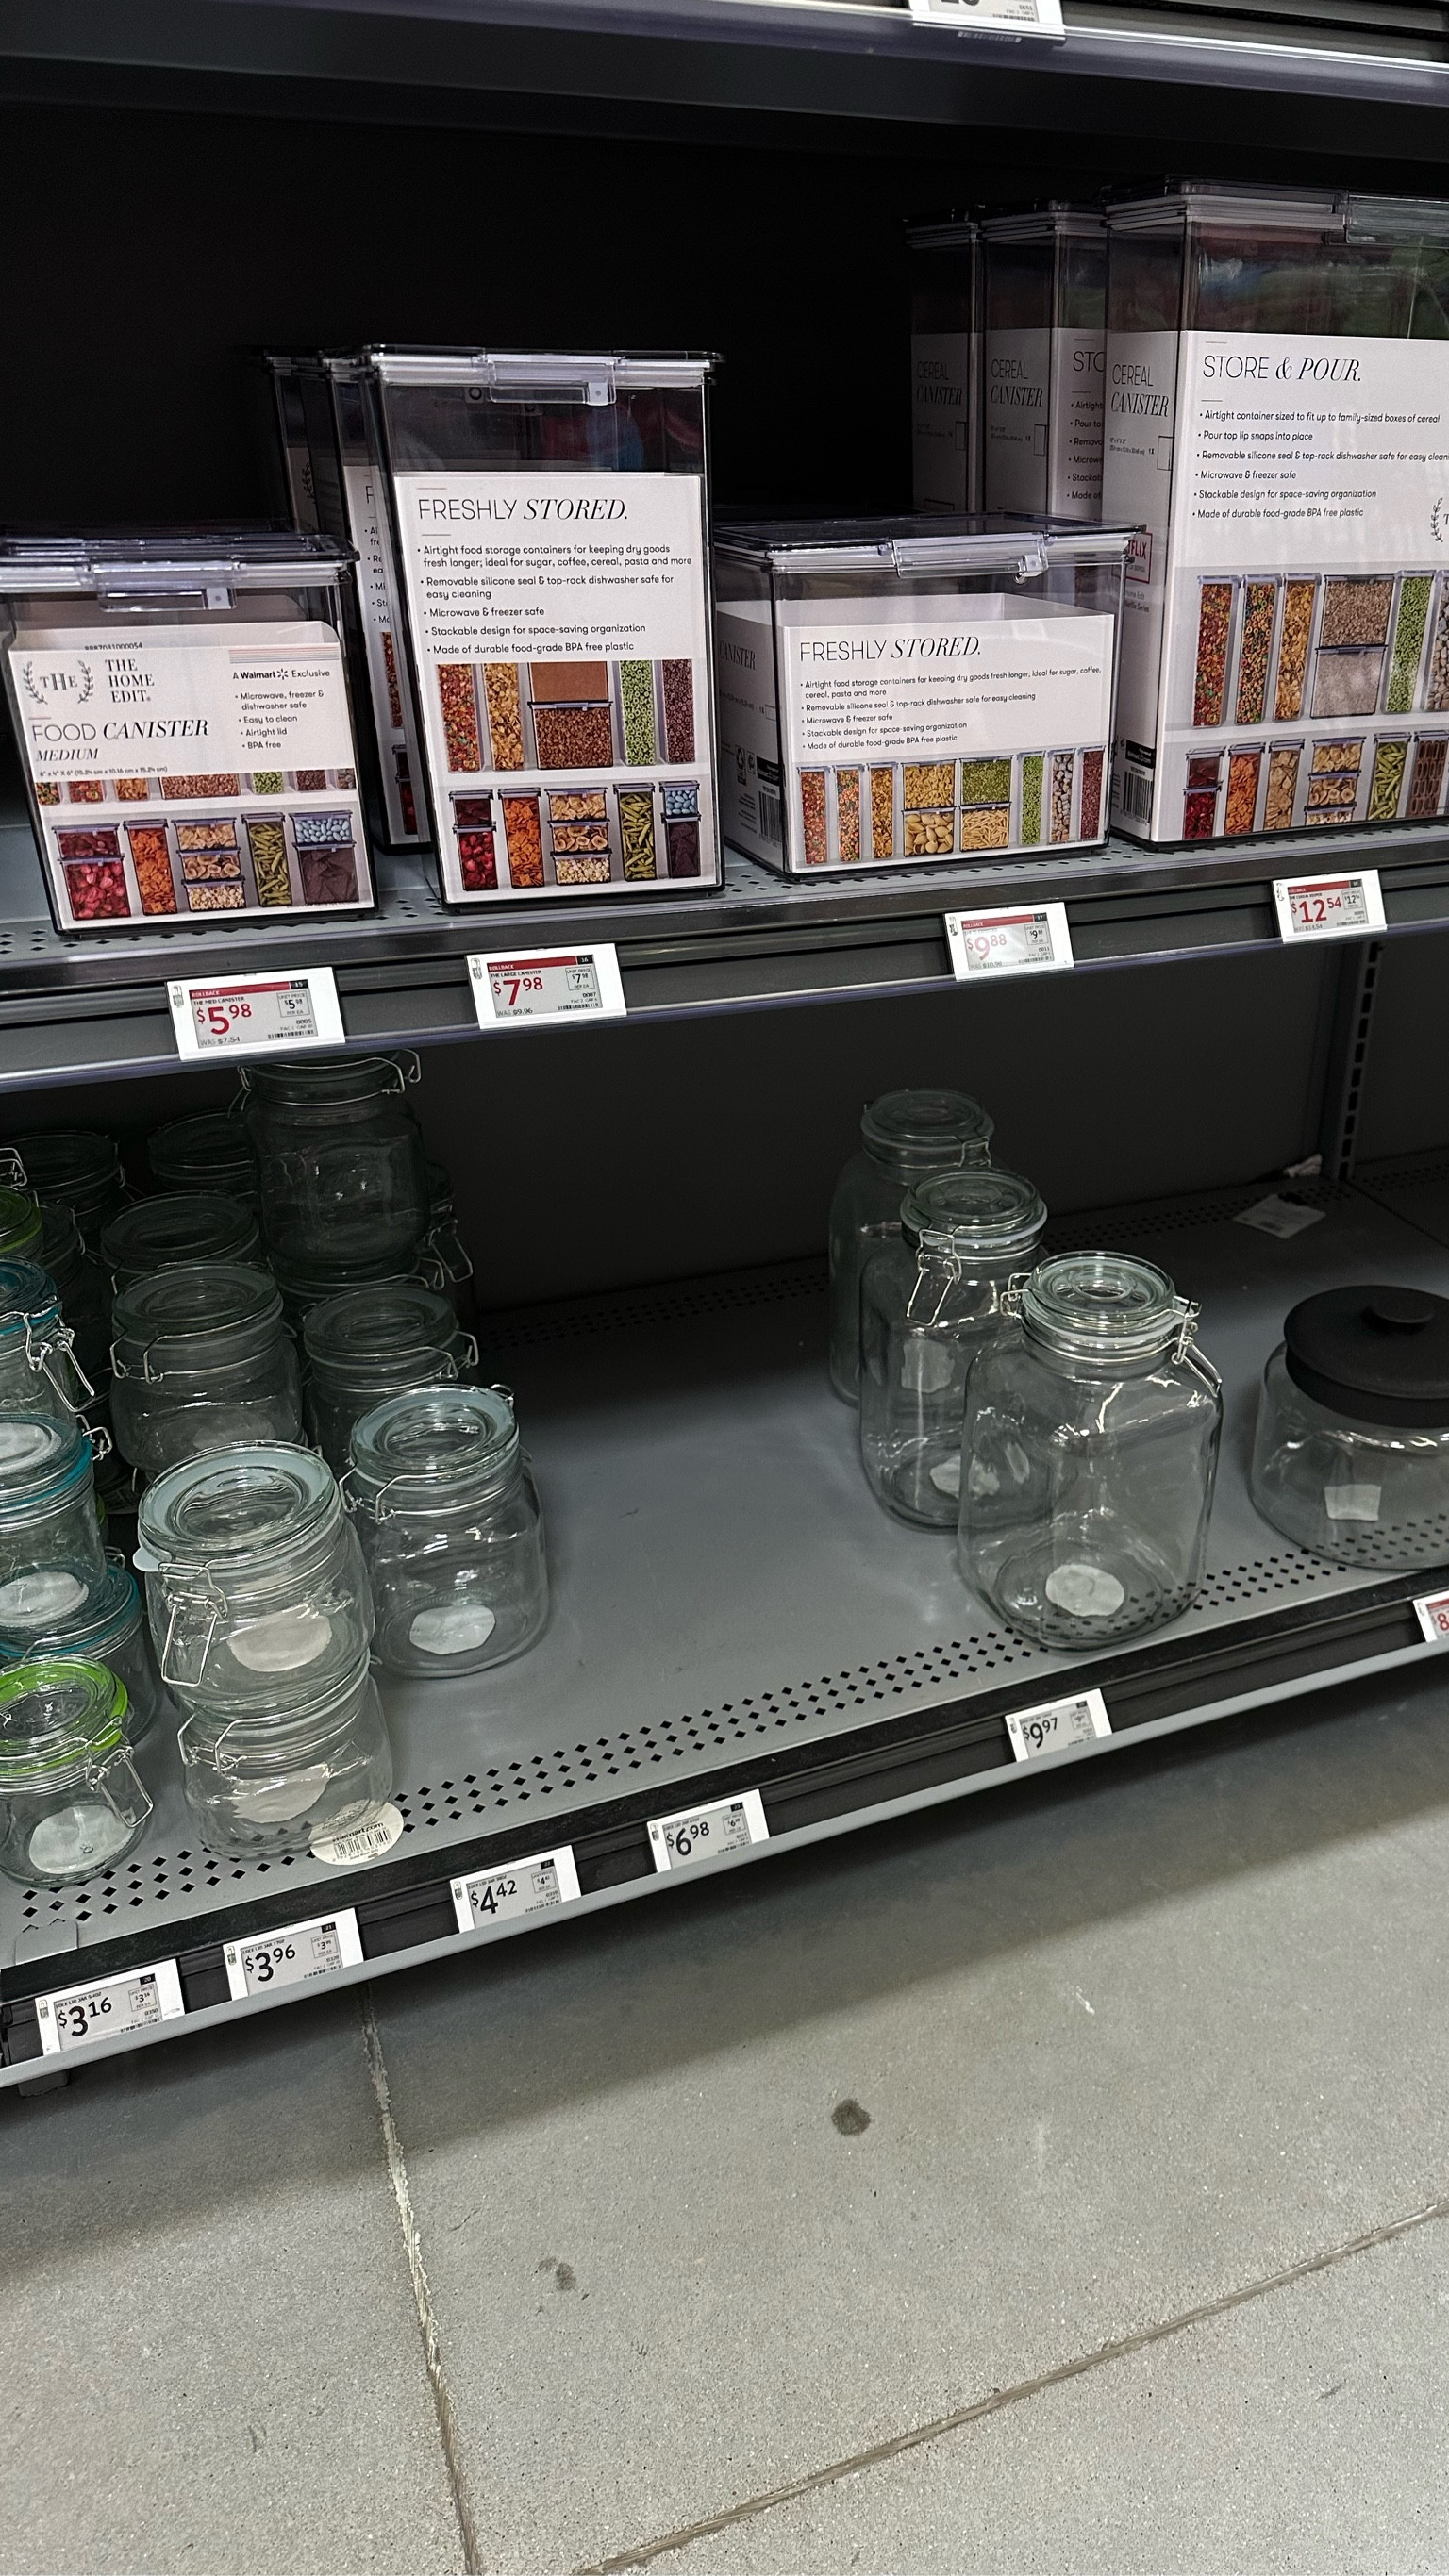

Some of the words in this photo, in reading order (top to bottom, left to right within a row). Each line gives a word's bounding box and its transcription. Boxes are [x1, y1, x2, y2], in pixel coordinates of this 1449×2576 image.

[991, 358, 1028, 380] CEREAL
[1112, 364, 1154, 387] CEREAL
[1203, 355, 1270, 379] STORE
[1275, 357, 1293, 380] &
[1296, 357, 1361, 382] POUR.
[991, 384, 1043, 407] CANISTER
[1110, 391, 1169, 417] CANISTER
[1204, 409, 1235, 423] Airtight
[1236, 410, 1274, 421] container
[1274, 410, 1296, 421] sized
[1296, 412, 1306, 422] to
[1306, 411, 1315, 422] fit
[1316, 414, 1327, 424] up
[1327, 412, 1337, 422] to
[1338, 411, 1384, 424] family-sized
[1384, 412, 1407, 423] boxes
[1407, 413, 1417, 424] of
[1416, 414, 1441, 424] cereal
[1203, 429, 1223, 440] Pour
[1224, 431, 1239, 442] top
[1239, 430, 1250, 442] lip
[1250, 432, 1274, 442] snaps
[1274, 430, 1291, 440] into
[1291, 431, 1314, 442] place
[1202, 450, 1246, 460] Removable
[1246, 450, 1276, 460] silicone
[1277, 450, 1294, 460] seal
[1294, 450, 1301, 460] &
[1302, 451, 1335, 462] top-rack
[1335, 450, 1378, 460] dishwasher
[1378, 451, 1396, 461] safe
[1396, 451, 1408, 461] for
[1408, 454, 1427, 463] easy
[1200, 470, 1243, 480] Microwave
[1244, 469, 1251, 480] &
[1252, 470, 1279, 479] freezer
[1279, 470, 1297, 479] safe
[418, 498, 518, 521] FRESHLY
[523, 498, 628, 520] STORED.
[423, 545, 459, 557] Airtight
[460, 544, 483, 555] food
[485, 546, 521, 557] storage
[523, 544, 572, 555] containers
[573, 544, 587, 554] for
[588, 544, 625, 557] keeping
[625, 543, 641, 556] dry
[642, 543, 671, 556] goods
[423, 557, 448, 568] fresh
[449, 557, 483, 570] longer;
[484, 557, 508, 567] ideal
[509, 557, 524, 567] for
[525, 559, 556, 569] sugar,
[557, 557, 590, 568] coffee,
[591, 557, 623, 567] cereal,
[624, 557, 650, 568] pasta
[651, 556, 669, 566] and
[425, 576, 479, 587] Removable
[480, 576, 516, 586] silicone
[517, 575, 537, 586] seal
[538, 575, 545, 586] &
[546, 574, 587, 588] top-rack
[588, 574, 640, 585] dishwasher
[641, 574, 659, 584] safe
[660, 573, 675, 584] for
[425, 591, 450, 601] easy
[451, 589, 492, 601] cleaning
[429, 607, 480, 618] Microwave
[482, 607, 490, 617] &
[491, 607, 523, 617] freezer
[525, 606, 545, 616] safe
[431, 625, 478, 637] Stackable
[479, 625, 511, 638] design
[512, 624, 526, 635] for
[527, 624, 589, 637] space-saving
[590, 623, 646, 636] organization
[433, 644, 460, 655] Made
[461, 644, 472, 654] of
[474, 643, 509, 654] durable
[511, 642, 564, 655] food-grade
[564, 641, 584, 652] BPA
[584, 641, 603, 652] free
[605, 641, 635, 654] plastic
[800, 640, 887, 662] FRESHLY
[891, 636, 981, 659] STORED.
[105, 658, 138, 672] THE
[108, 673, 155, 688] HOME
[241, 671, 275, 679] Walmart
[291, 669, 330, 678] Exclusive
[805, 679, 832, 690] Airtight
[833, 679, 850, 688] food
[851, 679, 879, 689] storage
[879, 676, 917, 686] containers
[917, 675, 928, 684] for
[928, 674, 956, 685] keeping
[956, 673, 968, 684] dry
[969, 672, 990, 683] goods
[990, 671, 1008, 680] fresh
[1031, 669, 1048, 677] ideal
[1048, 668, 1058, 676] for
[288, 690, 317, 699] freezer
[317, 690, 325, 698] &
[831, 690, 853, 700] pasta
[853, 689, 868, 697] and
[241, 702, 288, 711] dishwasher
[289, 700, 308, 709] safe
[242, 715, 264, 725] Easy
[264, 715, 275, 723] to
[275, 714, 298, 723] clean
[31, 723, 97, 742] FOOD
[103, 719, 208, 740] CANISTER
[245, 727, 276, 739] Airtight
[276, 727, 288, 736] lid
[247, 740, 264, 750] BPA
[265, 740, 282, 749] free
[38, 747, 99, 762] MEDIUM
